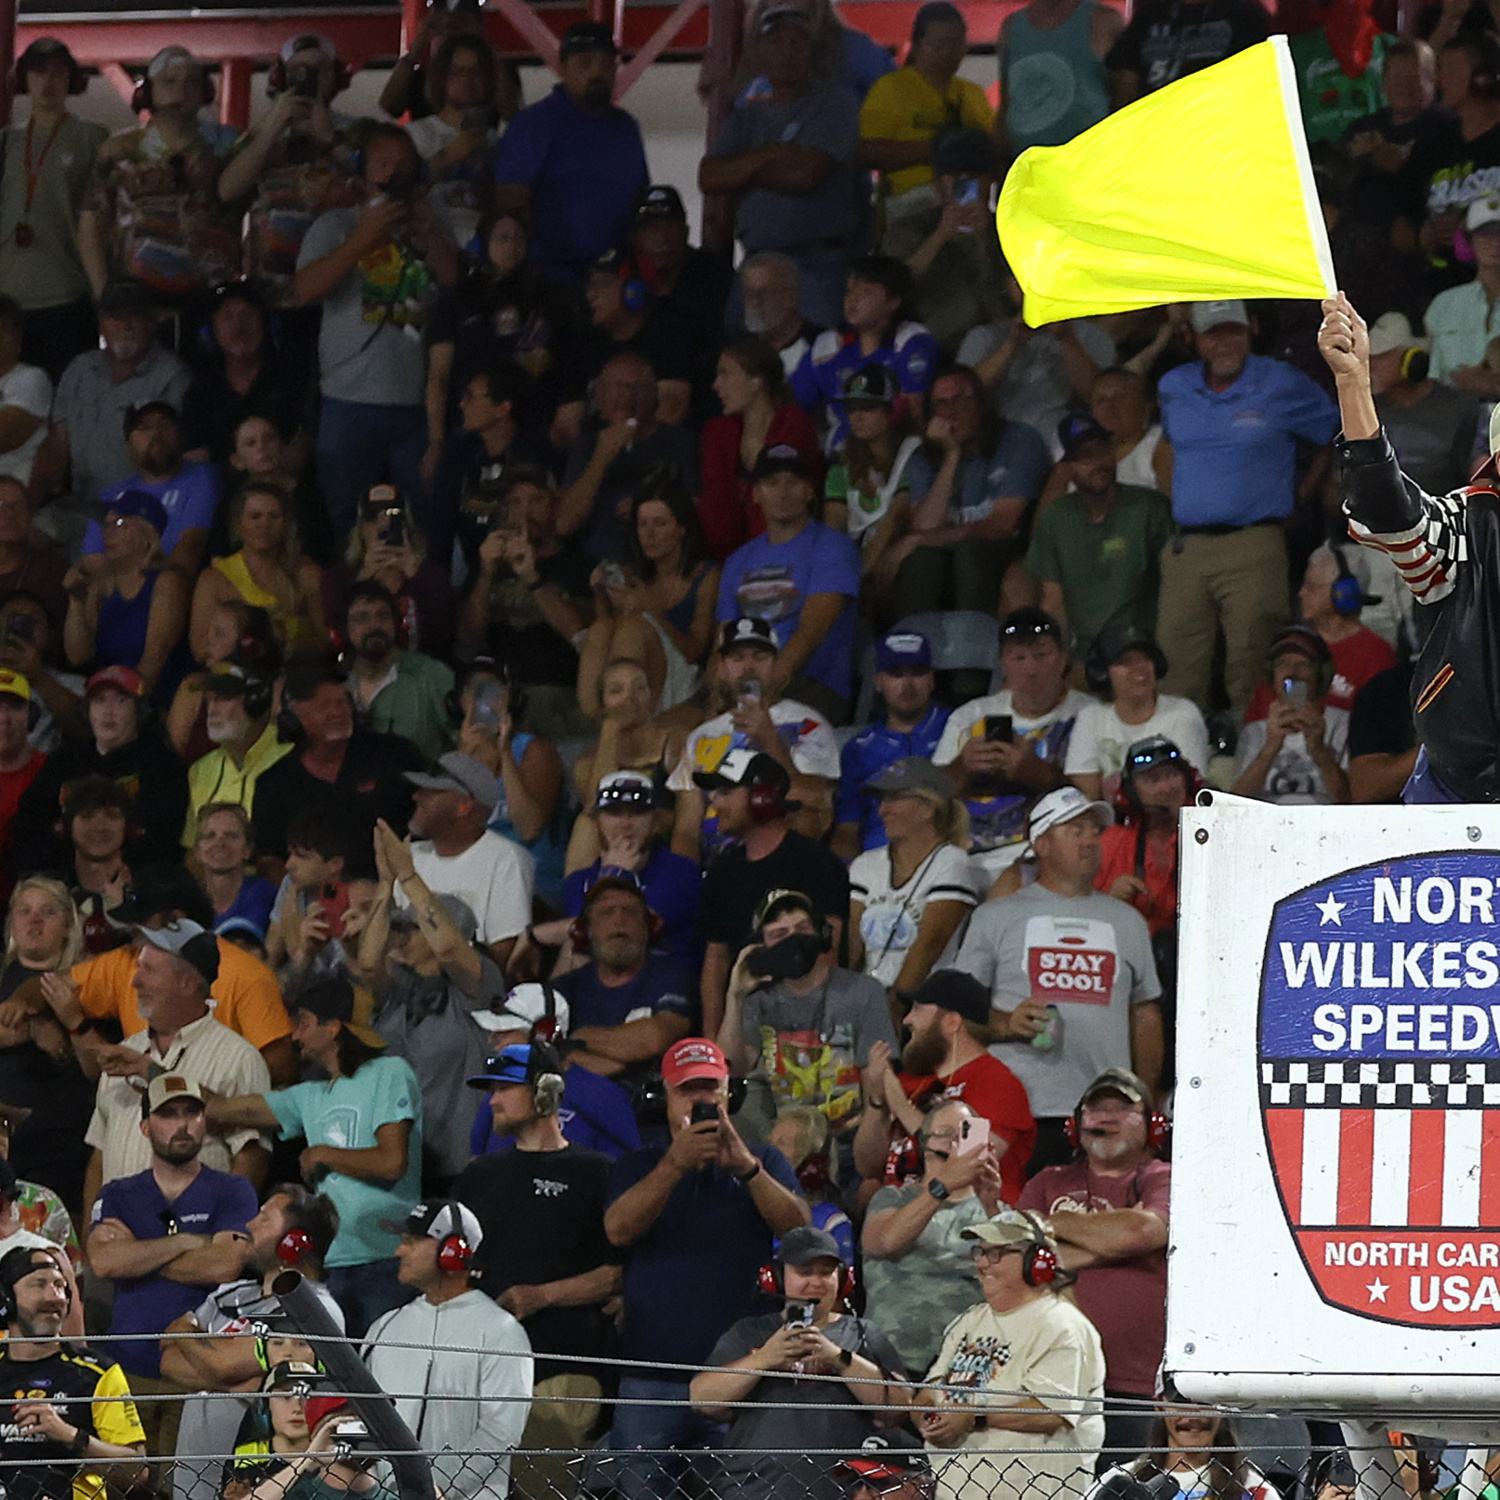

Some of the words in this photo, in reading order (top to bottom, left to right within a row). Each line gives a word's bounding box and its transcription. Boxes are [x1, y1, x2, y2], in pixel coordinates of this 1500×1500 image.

[1040, 951, 1106, 974] STAY
[1038, 972, 1107, 993] COOL
[1325, 1242, 1429, 1267] NORTH
